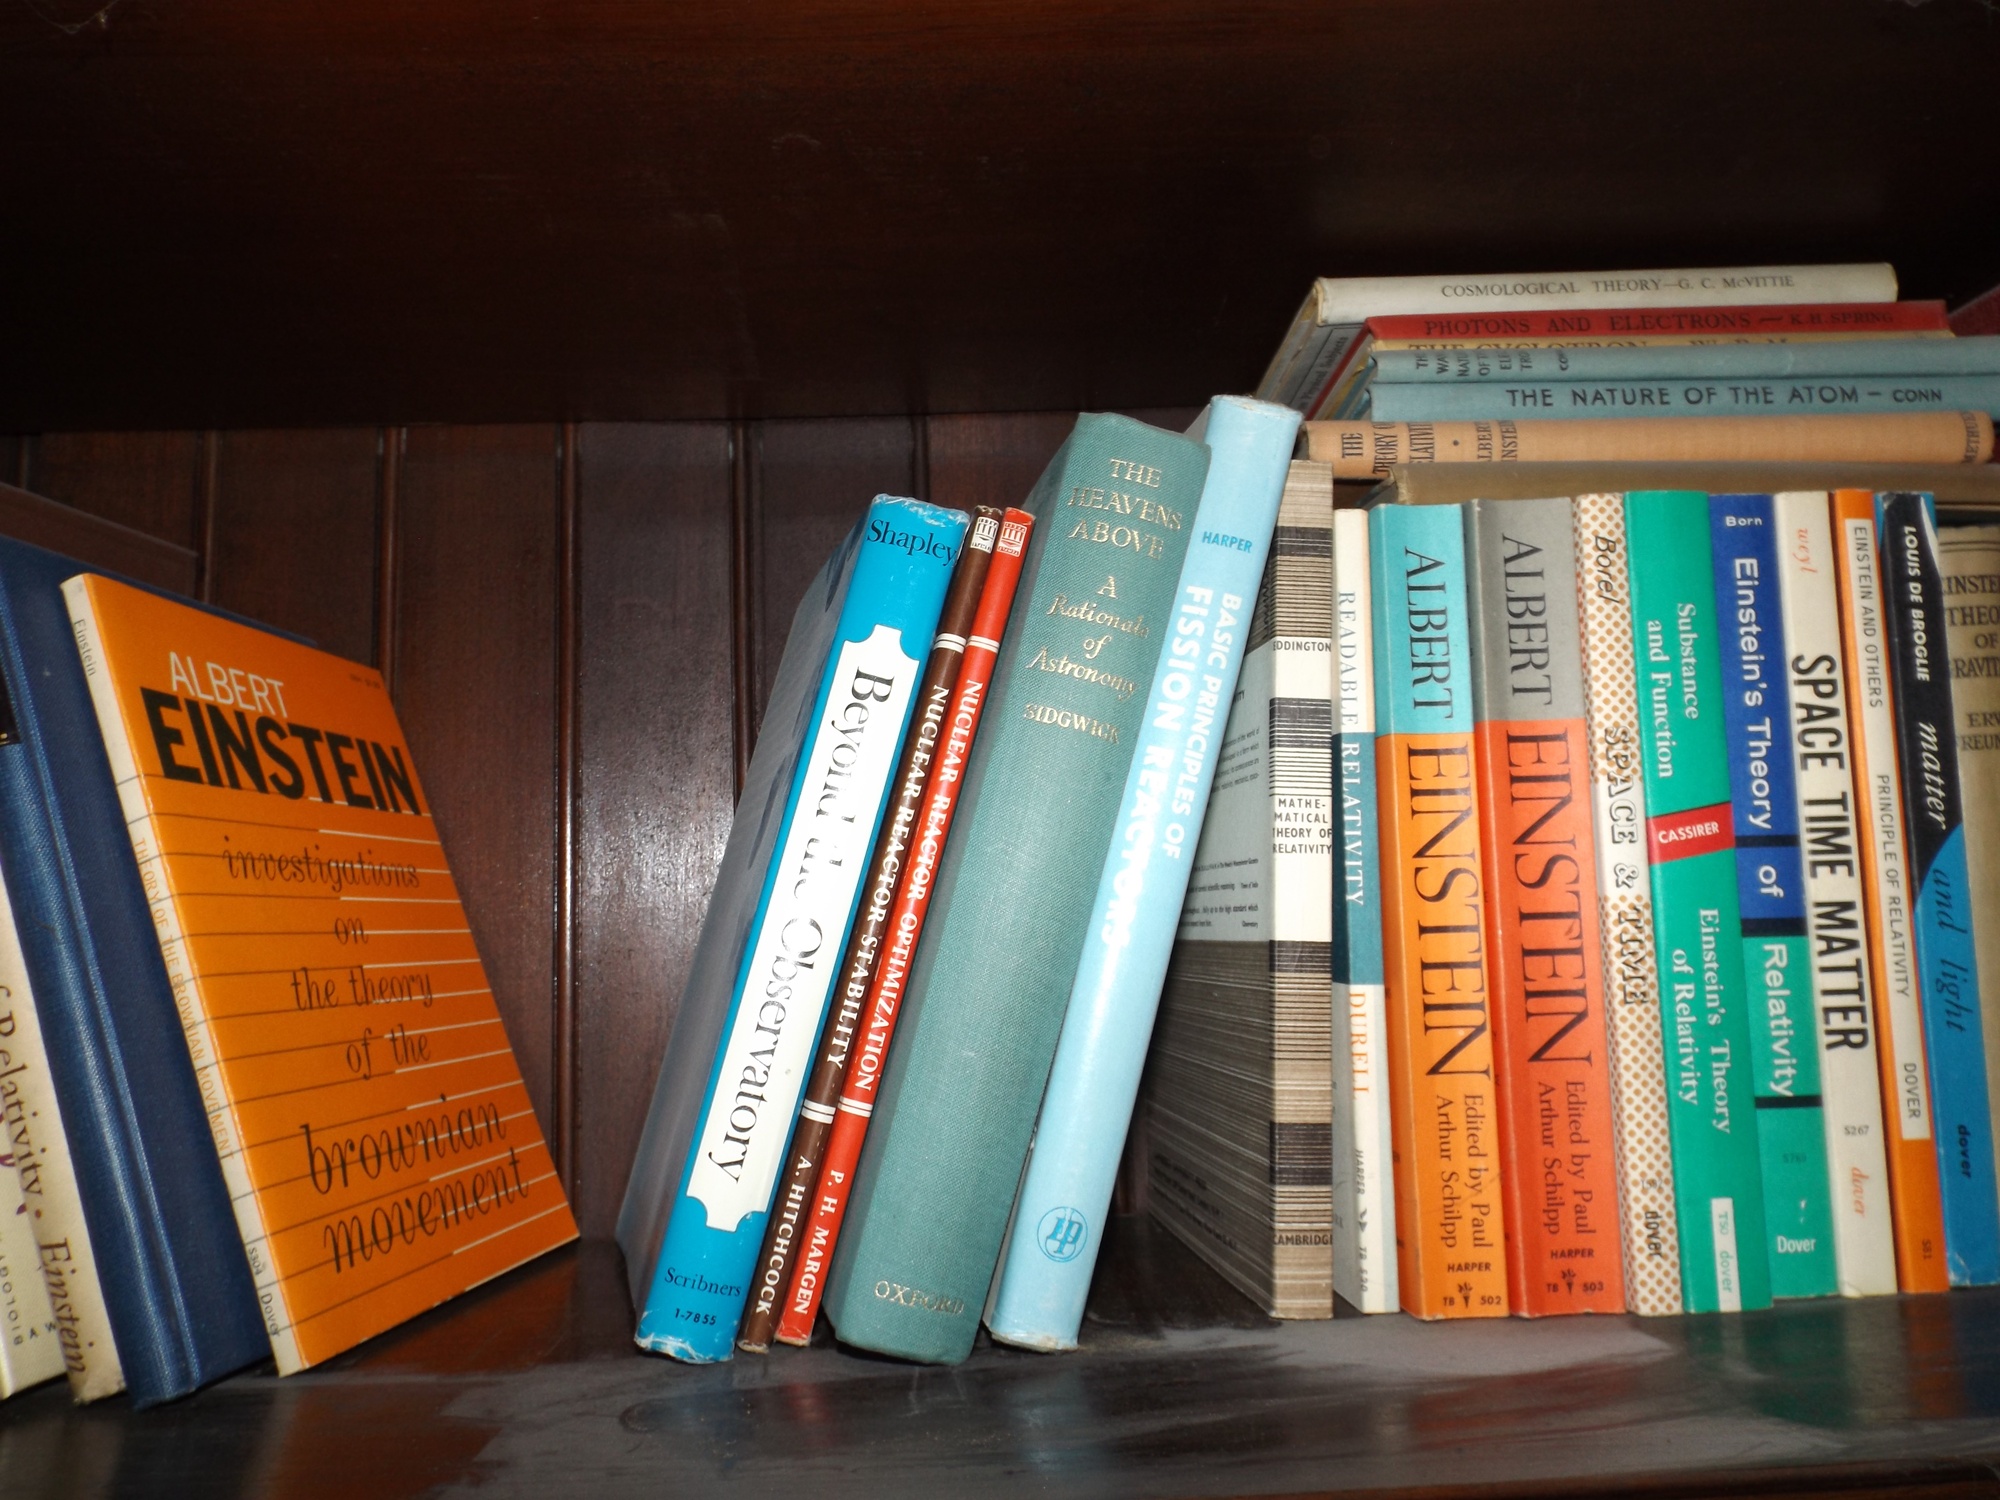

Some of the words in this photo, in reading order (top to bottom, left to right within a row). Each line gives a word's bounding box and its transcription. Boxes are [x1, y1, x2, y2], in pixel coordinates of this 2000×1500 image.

[1441, 280, 1580, 299] COSMOLOGICAL
[1425, 317, 1530, 336] PHOTONS
[1546, 315, 1591, 333] AND
[1609, 311, 1751, 332] ELECTRONS
[1506, 388, 1553, 407] THE
[1571, 387, 1671, 406] NATURE
[1684, 386, 1718, 404] OF
[1729, 386, 1774, 404] THE
[1788, 385, 1859, 404] ATOM
[1893, 388, 1942, 404] CONN
[1110, 459, 1162, 488] THE
[1341, 432, 1363, 458] THE
[1068, 486, 1184, 532] HEAVENS
[1724, 515, 1763, 527] Born
[866, 518, 960, 567] Shapley
[1068, 518, 1165, 561] ABOVE
[1202, 530, 1253, 554] HARPER
[1853, 526, 1874, 600] EINSTEIN
[1903, 525, 1922, 577] LOUIS
[1097, 575, 1118, 599] A
[1594, 535, 1621, 604] Borel
[1908, 582, 1924, 604] DE
[1047, 593, 1149, 640] Rationale
[1207, 592, 1243, 670] BASIC
[1404, 545, 1454, 719] ALBERT
[1501, 532, 1553, 706] ALBERT
[1647, 619, 1671, 663] and
[1861, 605, 1877, 638] AND
[1973, 632, 1999, 650] OF
[73, 618, 97, 677] Einstein
[1026, 645, 1140, 702] Astronomy
[1083, 635, 1112, 660] of
[1152, 585, 1214, 732] FISSION
[1339, 591, 1359, 726] READABLE
[1677, 602, 1699, 720] Substance
[1911, 608, 1931, 683] BROGLIE
[169, 651, 288, 718] ALBERT
[1865, 643, 1883, 708] OTHERS
[938, 679, 985, 782] NUCLEAR
[1023, 703, 1121, 744] SIDGWICK
[1651, 671, 1677, 778] Function
[1791, 653, 1845, 771] SPACE
[140, 686, 421, 816] EINSTEIN
[815, 665, 895, 824] Beyond
[903, 684, 951, 799] NUCLEAR
[1171, 674, 1223, 817] PRINCIPLES
[1604, 726, 1638, 845] SPACE
[1746, 716, 1773, 829] Theory
[1918, 720, 1947, 831] matter
[1274, 812, 1329, 825] MATICAL
[1278, 797, 1327, 809] MATHE-
[1341, 742, 1364, 907] RELATIVITY
[1876, 774, 1898, 862] PRINCIPLE
[905, 793, 952, 900] REACTOR
[1162, 822, 1186, 860] OF
[1272, 827, 1313, 839] THEORY
[1272, 842, 1333, 855] RELATIVITY
[1657, 821, 1720, 845] CASSIRER
[1803, 791, 1855, 879] TIME
[134, 838, 162, 902] THEORY
[220, 835, 420, 892] investigations
[866, 804, 915, 923] REACTOR
[1613, 862, 1640, 888] &
[1757, 864, 1785, 899] of
[1885, 869, 1900, 889] OF
[152, 907, 171, 930] OF
[1407, 741, 1492, 1081] EINSTEIN
[1506, 726, 1594, 1068] EINSTEIN
[1932, 867, 1969, 935] and
[161, 934, 181, 969] THE
[333, 914, 369, 947] on
[1888, 896, 1910, 998] RELATIVITY
[291, 966, 340, 1012] the
[348, 964, 434, 1010] theory
[1672, 948, 1694, 975] of
[1813, 900, 1870, 1051] MATTER
[171, 972, 206, 1062] BROWNIAN
[827, 933, 879, 1070] STABILITY
[855, 911, 919, 1092] OPTIMIZATION
[1762, 943, 1798, 1097] Relativity
[1935, 957, 1974, 1034] light
[346, 1027, 374, 1080] of
[389, 1023, 431, 1064] the
[708, 916, 824, 1185] Observatory
[1348, 991, 1370, 1099] DURELL
[1673, 982, 1702, 1106] Relativity
[197, 1065, 235, 1161] MOVEMENT
[1538, 1081, 1560, 1148] Arthur
[1565, 1080, 1590, 1145] Edited
[1710, 1038, 1732, 1135] Theory
[1903, 1062, 1922, 1120] DOVER
[300, 1094, 507, 1196] brownian
[1437, 1094, 1458, 1162] Arthur
[1464, 1093, 1488, 1158] Edited
[1844, 1125, 1870, 1137] S267
[1957, 1124, 1973, 1180] dover
[794, 1154, 814, 1178] A.
[827, 1169, 845, 1187] P.
[1465, 1167, 1490, 1195] by
[1567, 1153, 1592, 1181] by
[1850, 1165, 1870, 1218] dover
[323, 1148, 531, 1274] movement
[819, 1195, 839, 1217] H.
[1440, 1171, 1463, 1249] Schilpp
[1542, 1157, 1566, 1235] Schilpp
[1573, 1188, 1597, 1235] Paul
[755, 1183, 807, 1316] HITCHCOCK
[1471, 1202, 1494, 1249] Paul
[1550, 1248, 1594, 1260] HARPER
[1644, 1210, 1663, 1258] dover
[1776, 1235, 1816, 1254] Dover
[664, 1266, 742, 1300] Scribners
[793, 1227, 830, 1316] MARGEN
[1447, 1261, 1492, 1274] HARPER
[1719, 1250, 1734, 1293] dover
[40, 1237, 95, 1374] Einstein
[260, 1292, 281, 1338] Dover
[674, 1307, 718, 1327] 1-7855
[874, 1279, 966, 1316] OXFORD
